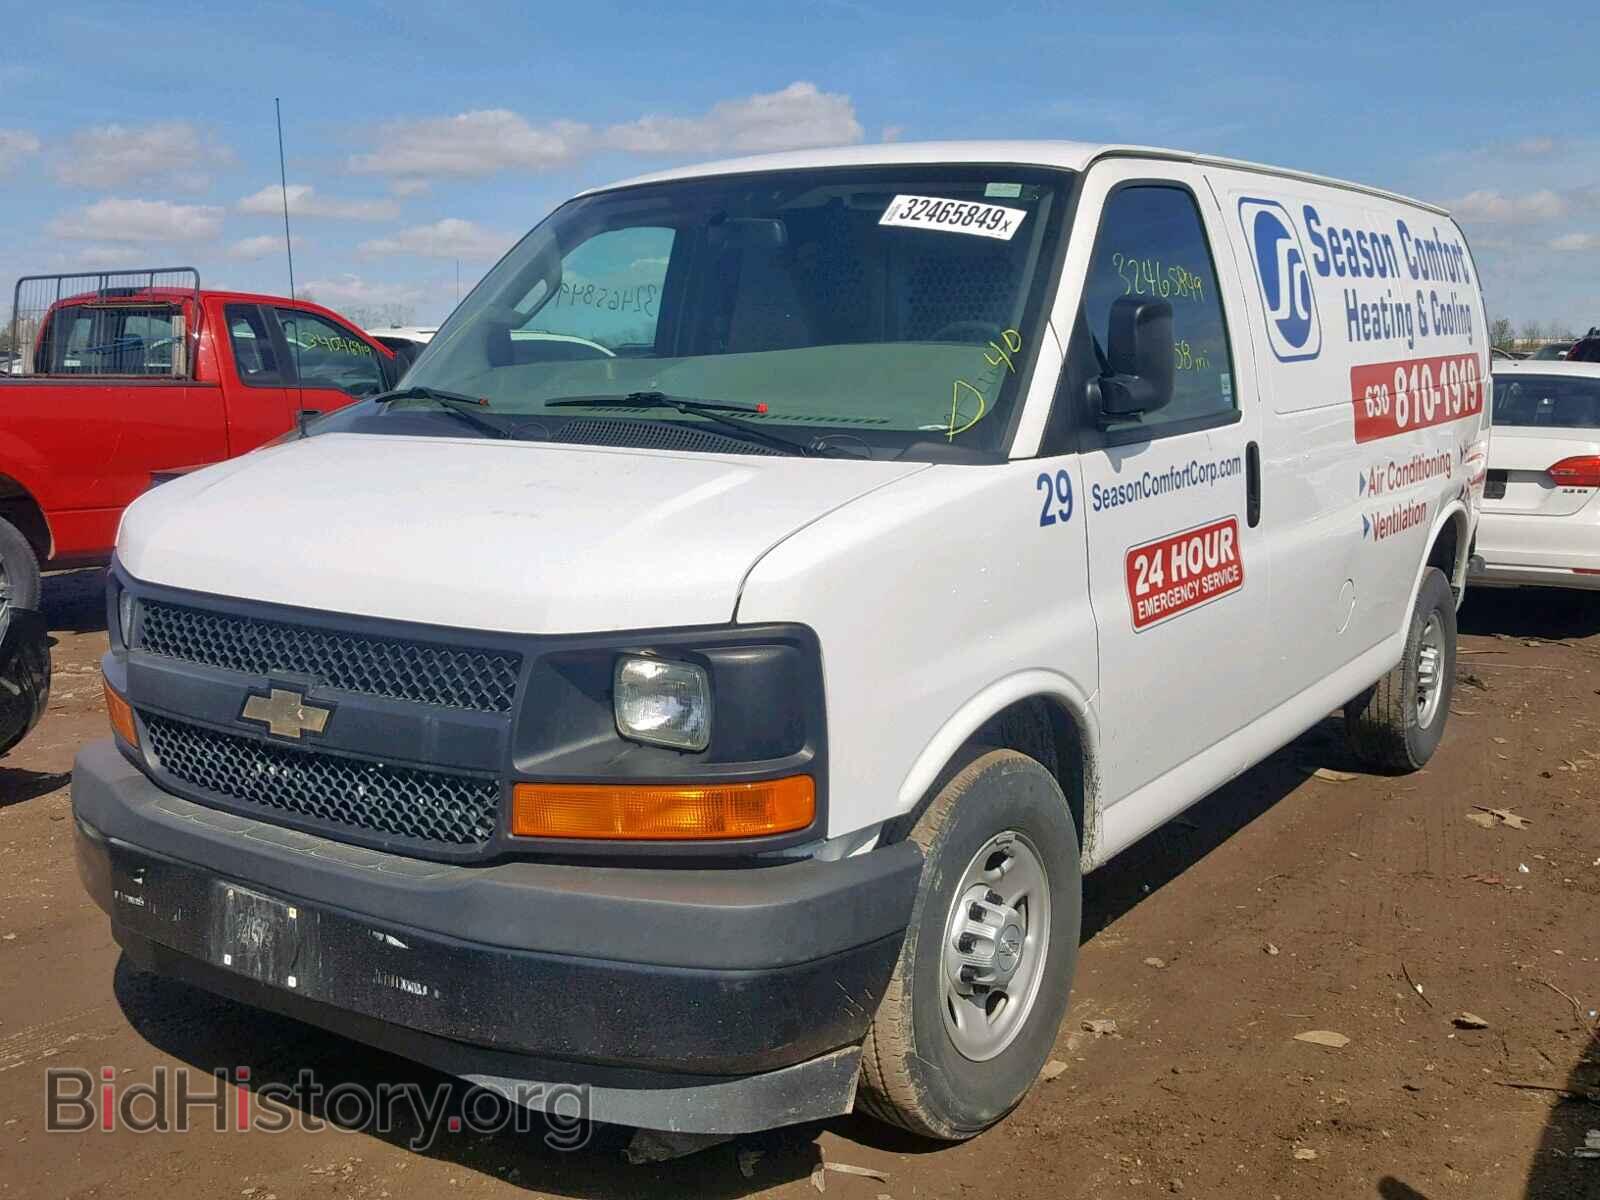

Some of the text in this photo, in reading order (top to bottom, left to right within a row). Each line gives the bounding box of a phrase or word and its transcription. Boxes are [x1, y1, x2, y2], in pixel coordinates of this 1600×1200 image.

[1303, 205, 1471, 285] Season Comfort
[1344, 288, 1473, 350] Heating & Cooling
[1364, 357, 1478, 429] 630 810-1919
[1036, 469, 1073, 527] 29
[1092, 456, 1241, 511] SeasonComfortCorp.com
[1367, 467, 1385, 496] Air
[1388, 451, 1451, 490] Conditioning
[1372, 502, 1427, 541] Ventilation
[1134, 526, 1235, 596] 24 HOUR
[1138, 564, 1239, 620] EMERGENCY SERVICE
